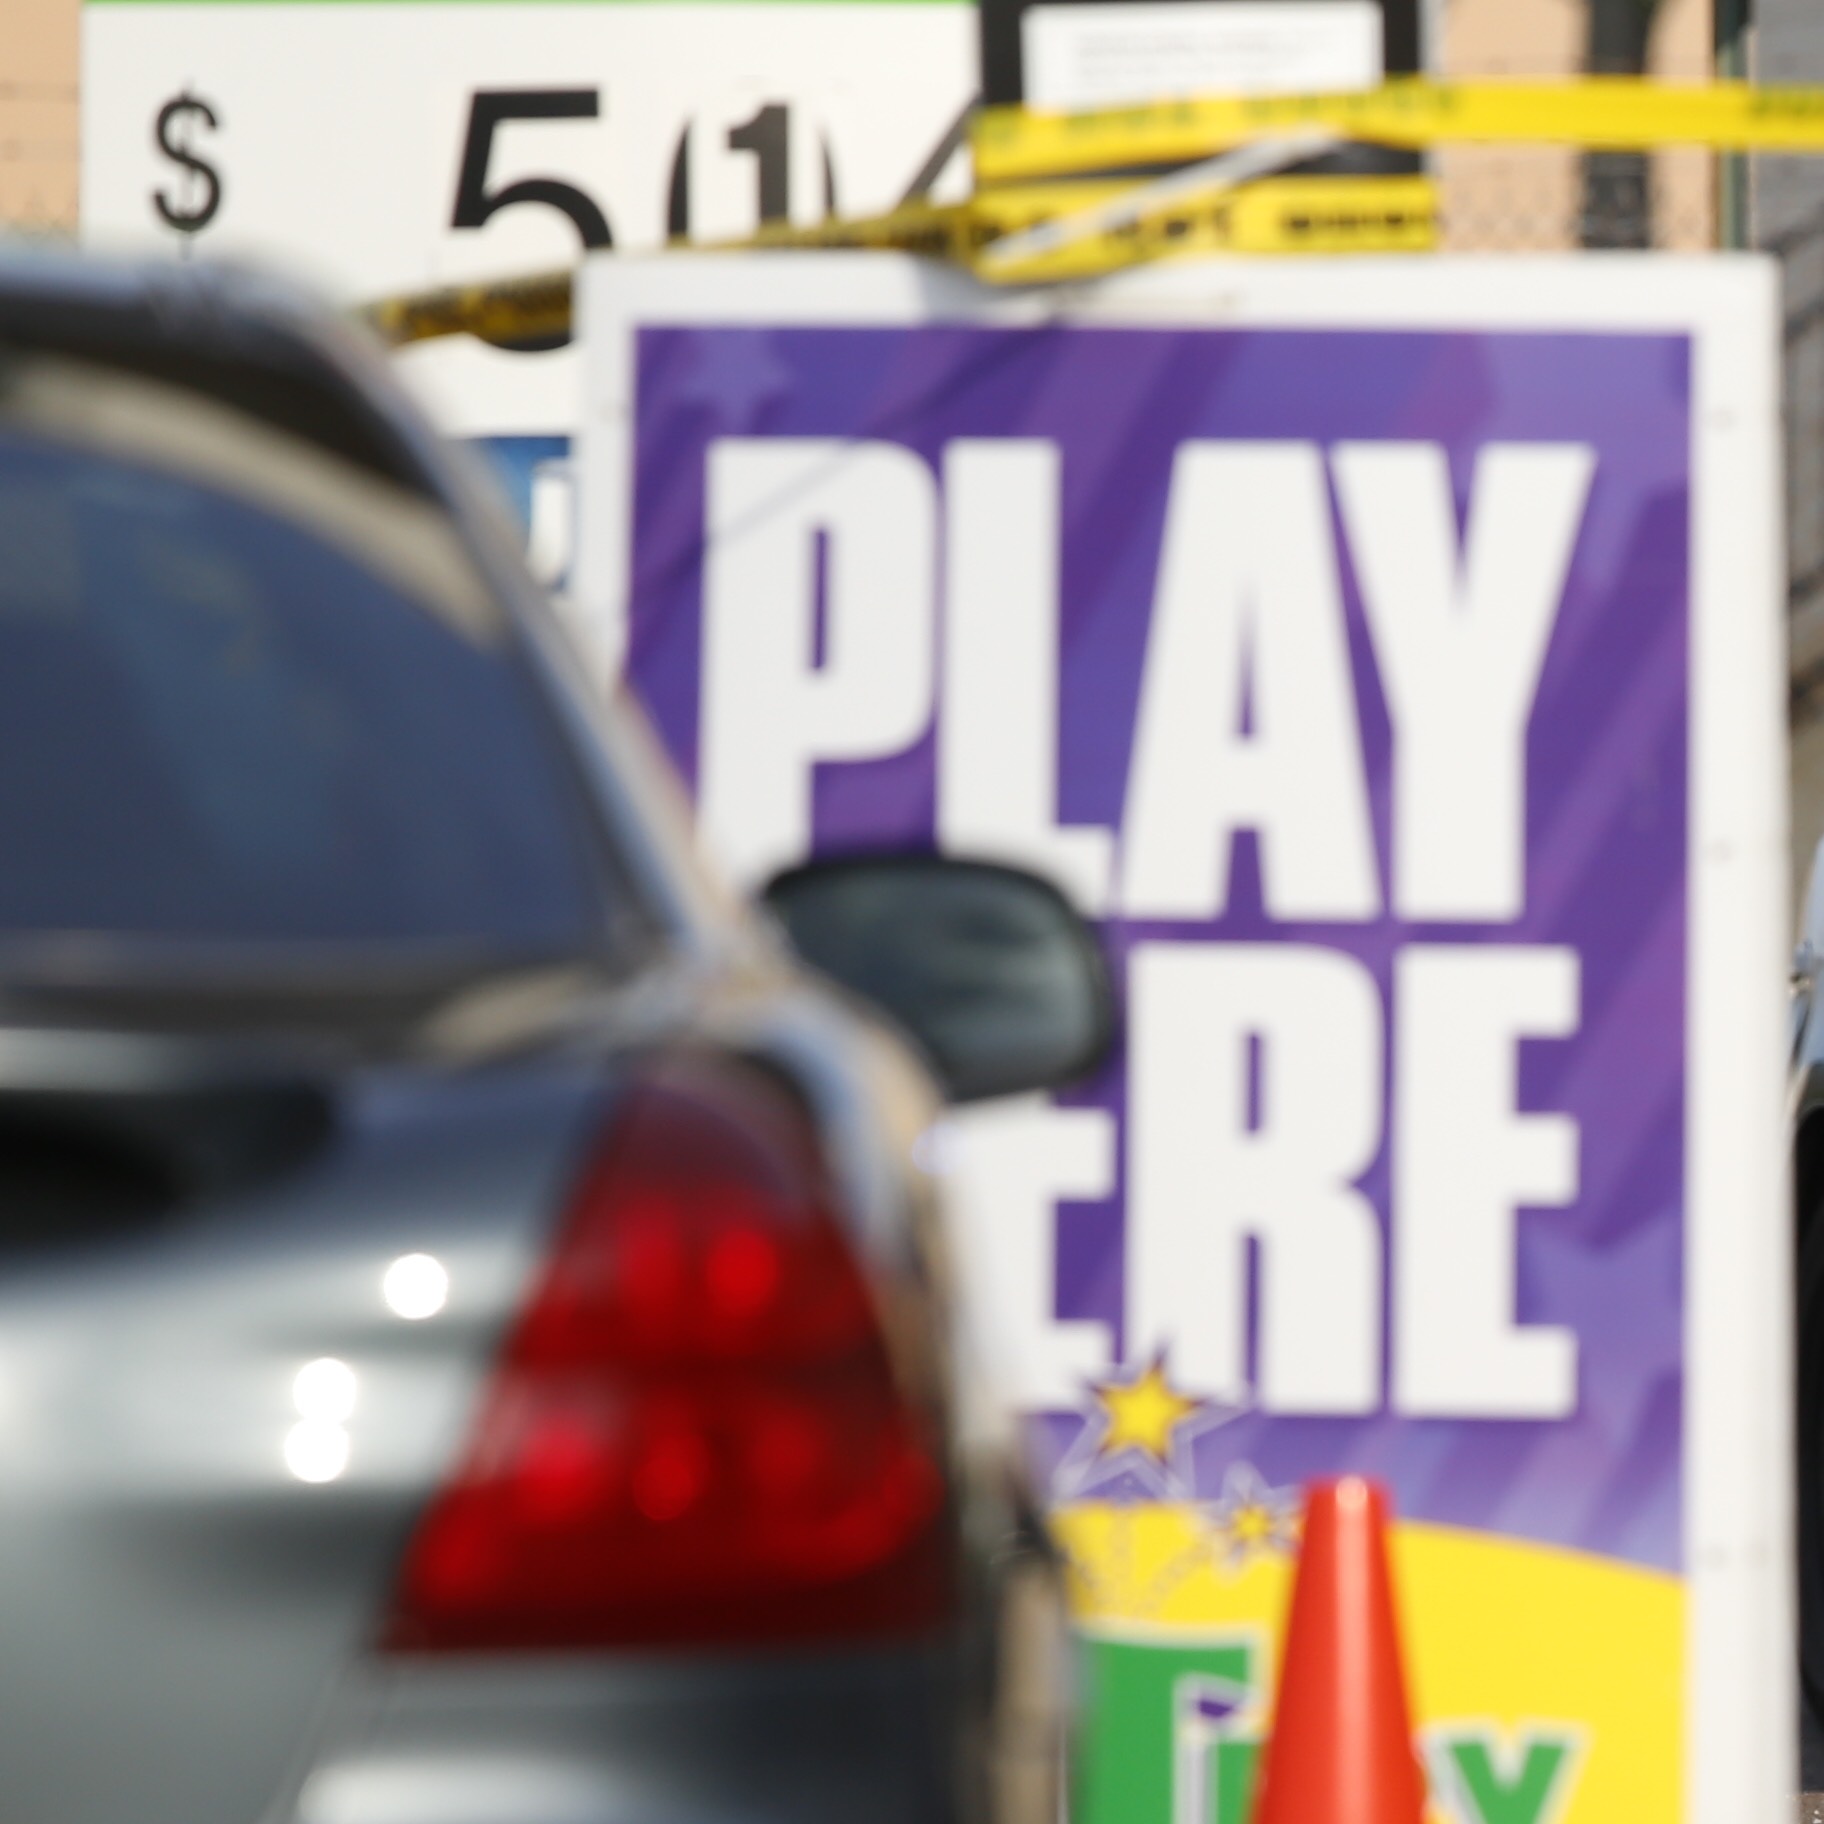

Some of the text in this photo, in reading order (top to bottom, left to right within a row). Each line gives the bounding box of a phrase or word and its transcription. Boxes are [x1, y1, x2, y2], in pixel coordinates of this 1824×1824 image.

[153, 82, 223, 240] $
[695, 437, 1595, 922] PLAY
[932, 944, 1582, 1418] ERE
